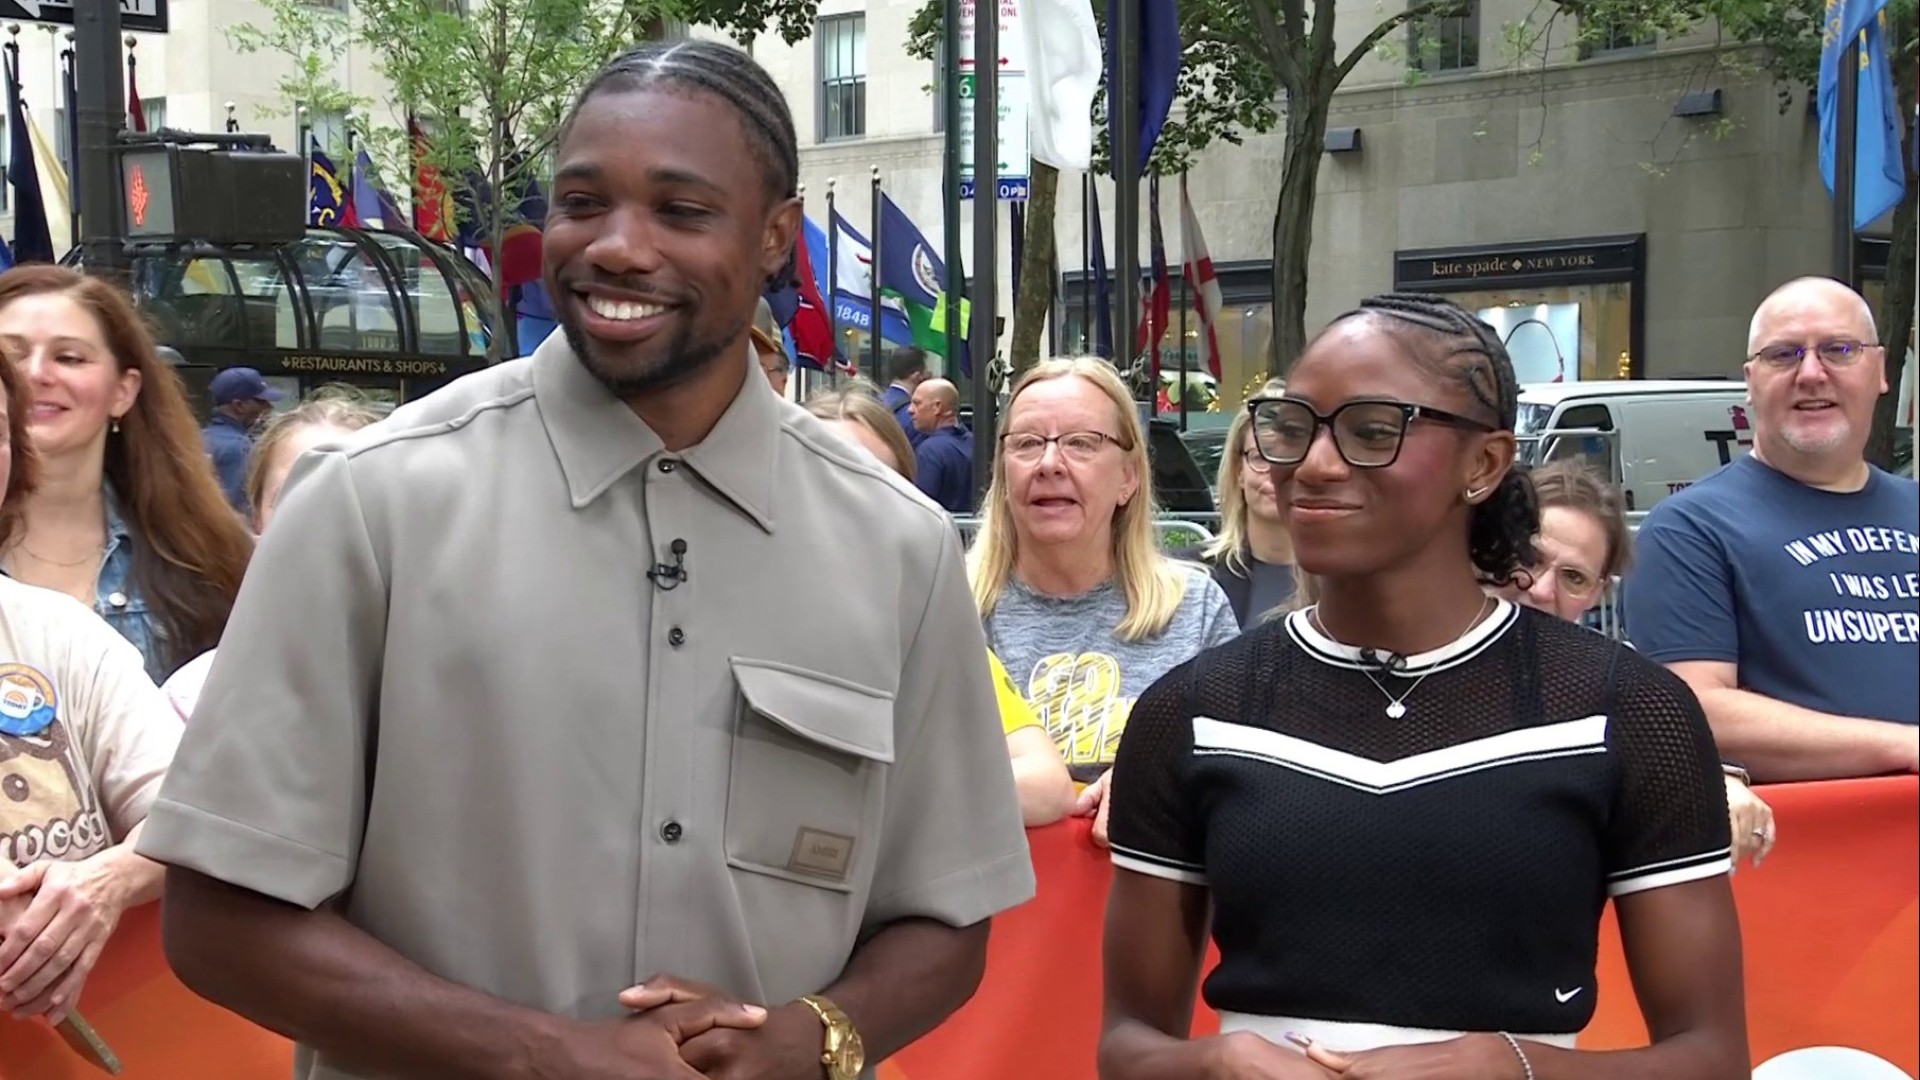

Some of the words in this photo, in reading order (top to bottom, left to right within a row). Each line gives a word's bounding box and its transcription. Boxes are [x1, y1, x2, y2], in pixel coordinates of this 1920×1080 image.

[1001, 8, 1018, 17] ONL
[1432, 261, 1462, 276] kate
[1466, 257, 1507, 277] spade
[1527, 257, 1556, 270] NEW
[1560, 254, 1595, 267] YORK
[836, 304, 870, 326] 1848
[291, 356, 381, 373] RESTAURANTS
[383, 360, 393, 373] &
[395, 361, 438, 374] SHOPS
[1784, 539, 1819, 566] IN
[1807, 530, 1848, 557] MY
[1829, 572, 1843, 595] I
[1841, 573, 1889, 600] WAS
[1803, 609, 1919, 643] UNSUPER
